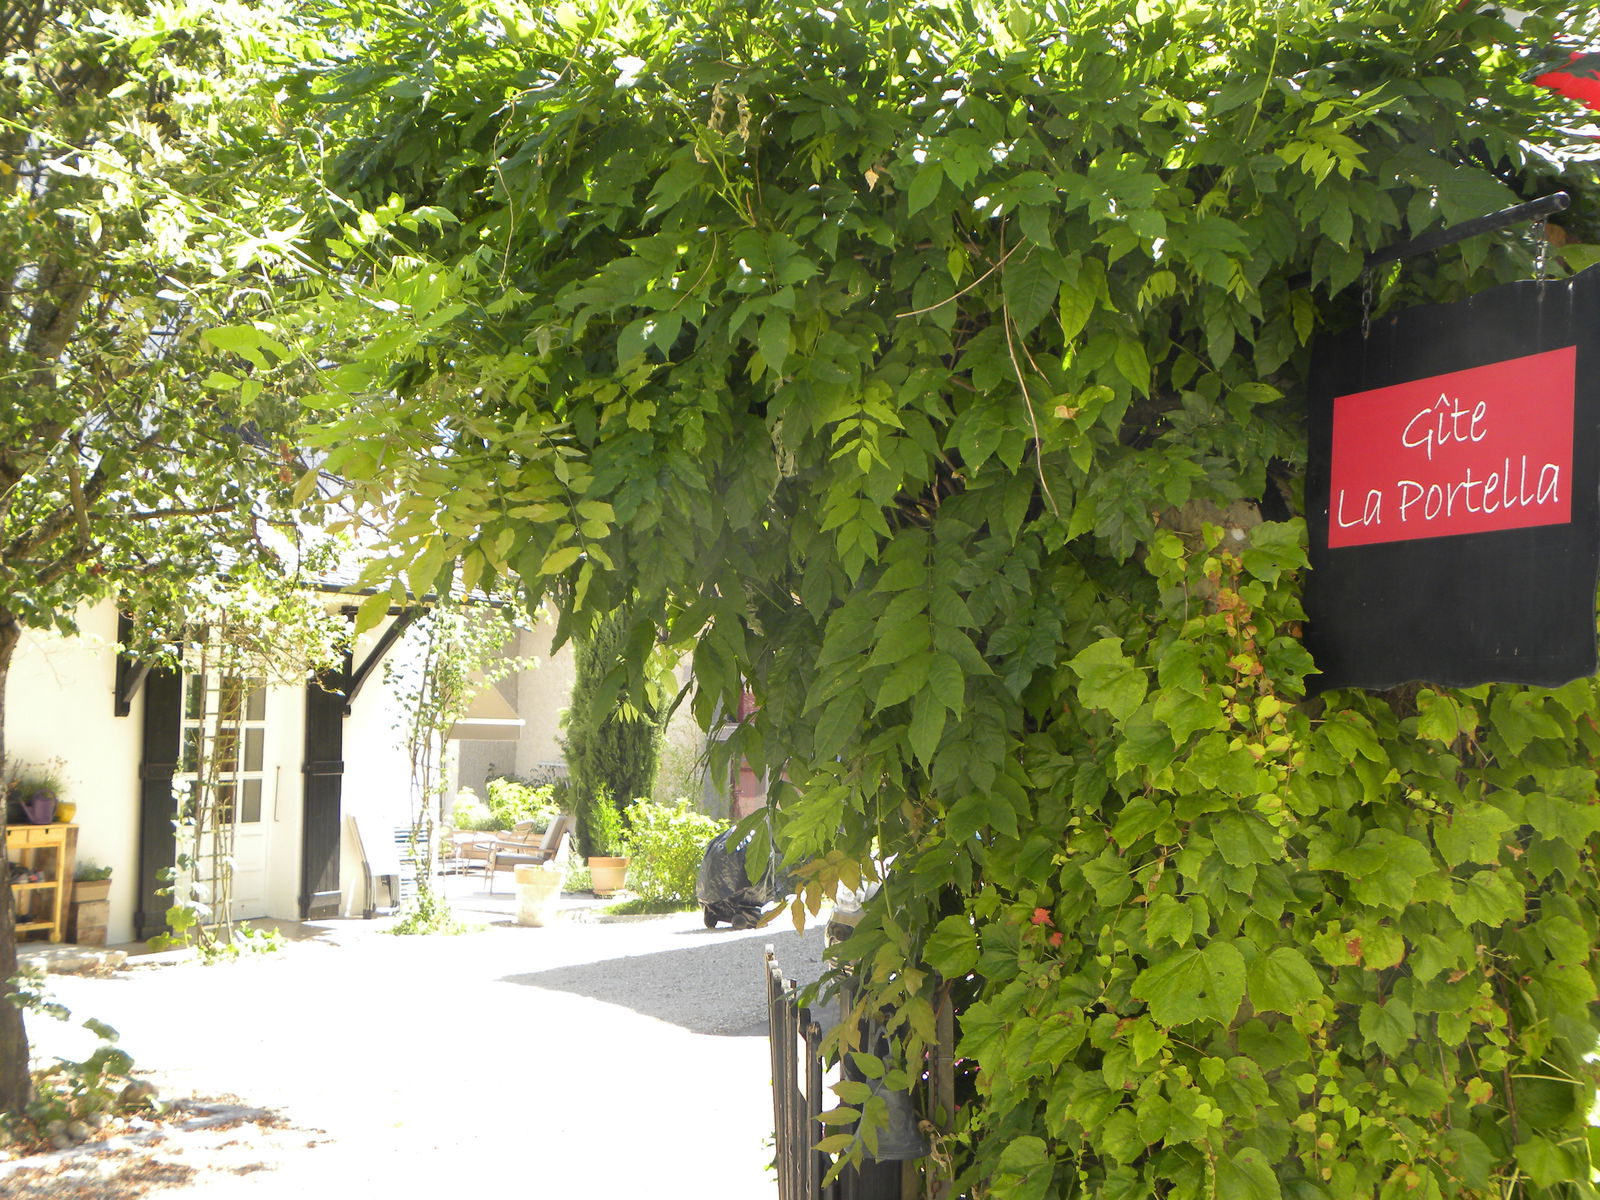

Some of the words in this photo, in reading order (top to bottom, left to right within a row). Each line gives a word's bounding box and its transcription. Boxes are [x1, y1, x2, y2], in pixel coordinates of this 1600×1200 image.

[1402, 393, 1487, 461] Gîte
[1337, 489, 1382, 528] La
[1397, 455, 1560, 522] Portella
